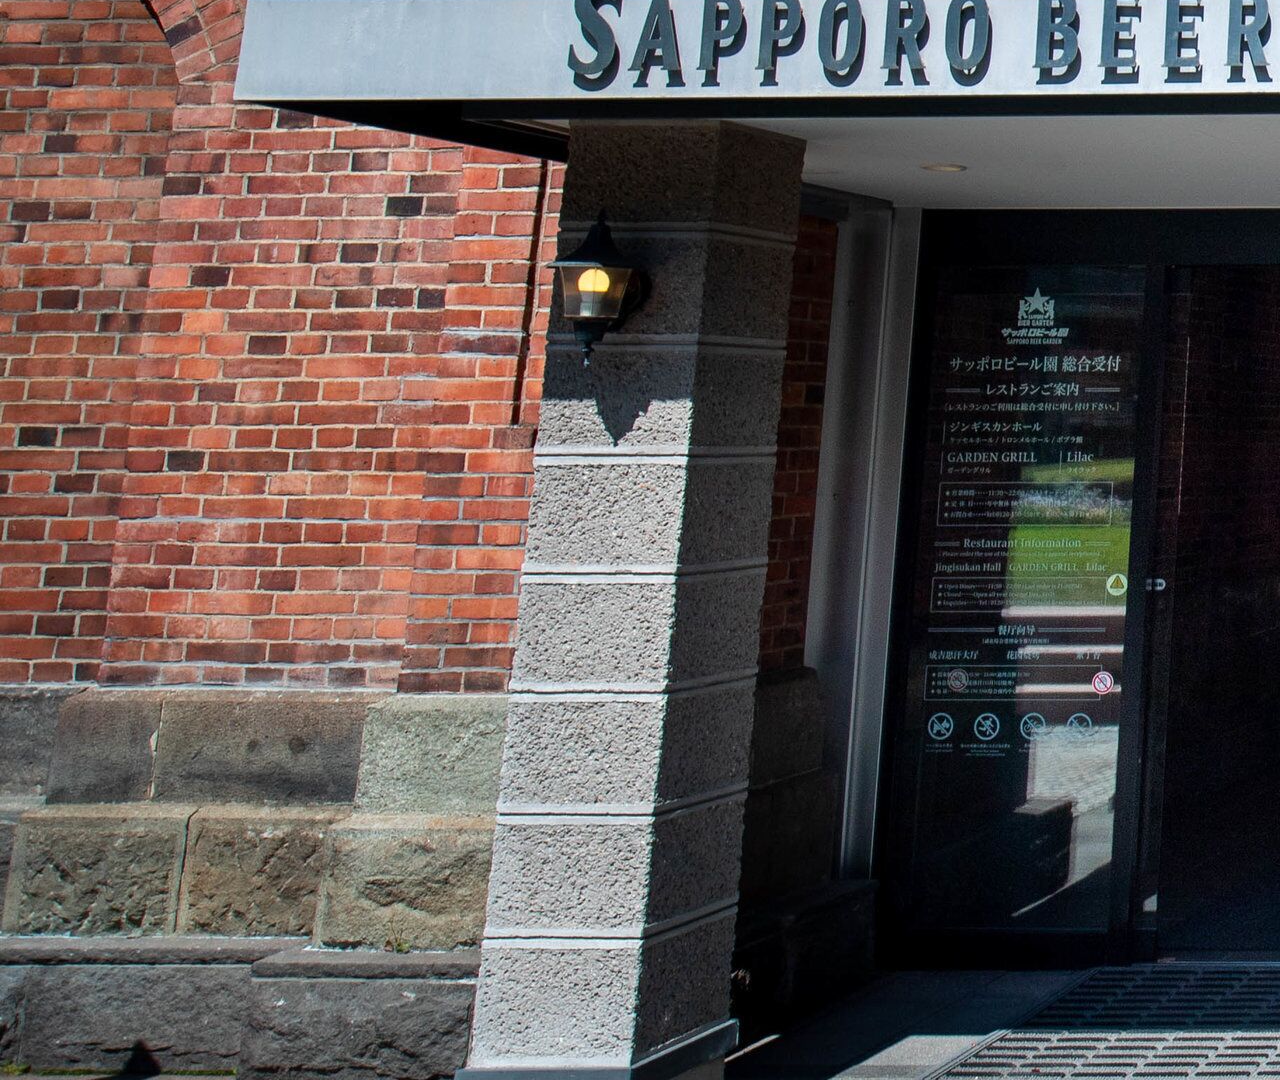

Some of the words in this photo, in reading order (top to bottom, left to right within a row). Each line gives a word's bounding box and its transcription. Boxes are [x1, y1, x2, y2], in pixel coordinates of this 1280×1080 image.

[949, 355, 1058, 373] サッポロビール園
[1062, 354, 1121, 373] 総合受付
[986, 382, 1079, 397] レストランご案内
[949, 420, 1043, 433] ジンギスカンホール
[947, 451, 999, 463] GARDEN
[1001, 451, 1038, 463] GRILL
[1067, 450, 1095, 463] Lilac
[963, 537, 1017, 548] Restaurant
[1021, 537, 1081, 548] Information
[934, 562, 980, 573] Jingisukan
[983, 562, 1001, 572] Hall
[1009, 563, 1048, 572] GARDEN
[1050, 563, 1079, 572] GRILL
